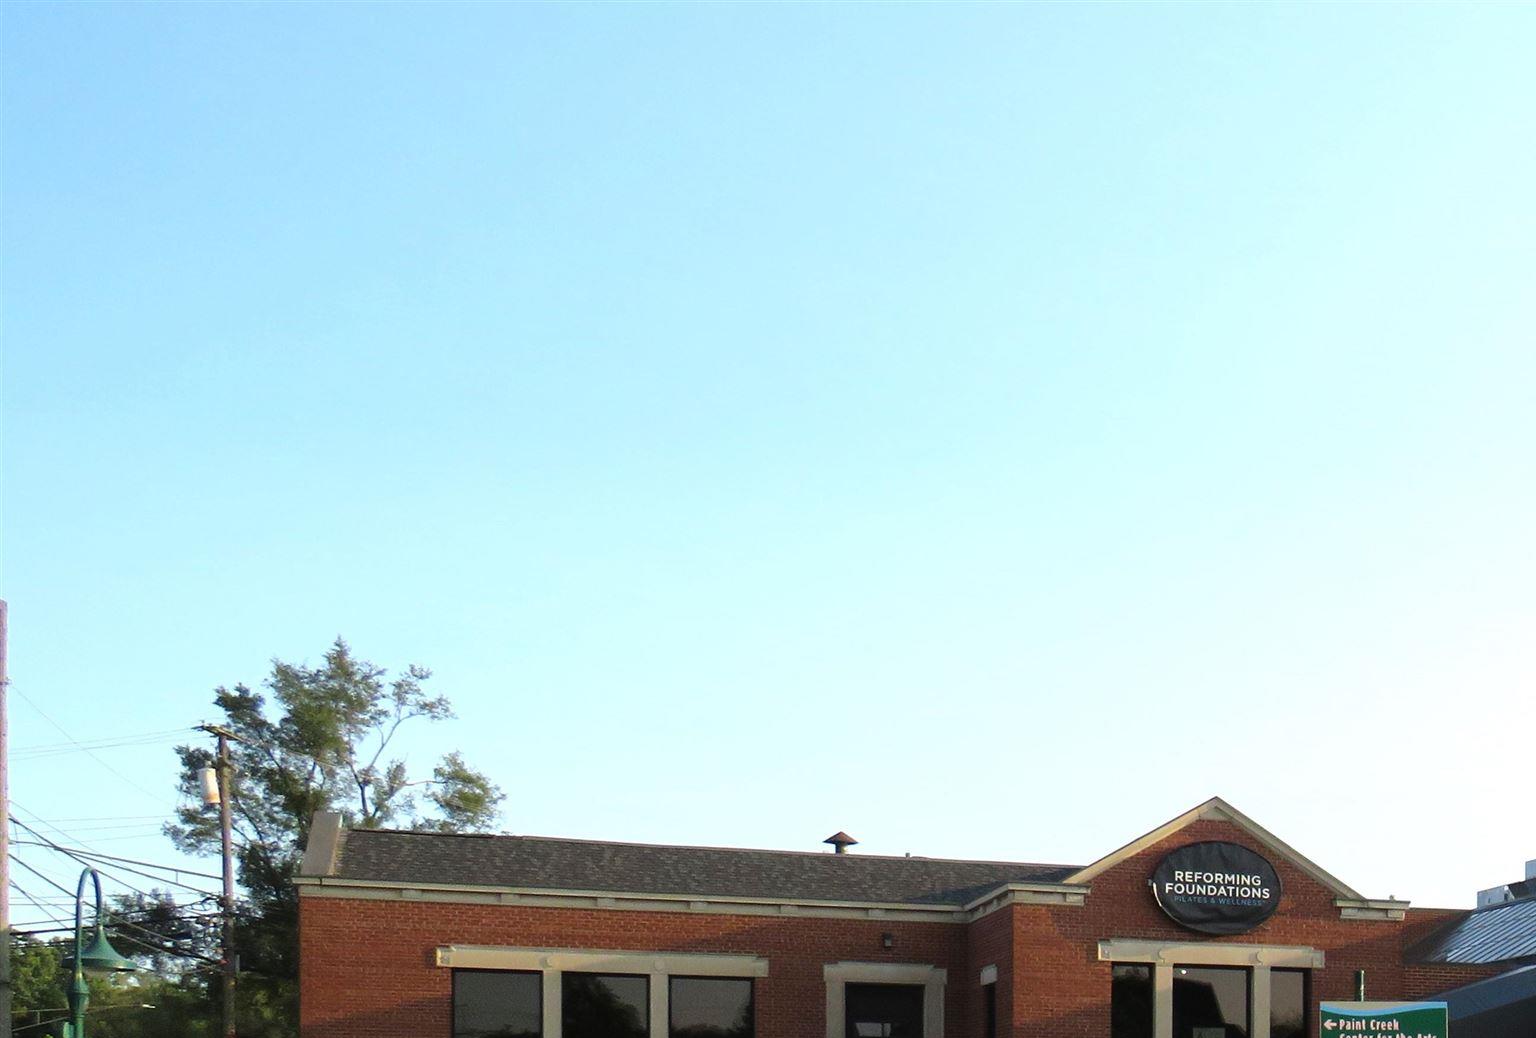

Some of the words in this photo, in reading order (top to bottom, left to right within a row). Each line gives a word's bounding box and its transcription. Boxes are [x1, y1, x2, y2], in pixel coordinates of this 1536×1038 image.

[1174, 870, 1262, 887] REFORMING
[1165, 882, 1270, 899] FOUNDATIONS
[1174, 896, 1208, 904] PILATES
[1218, 898, 1262, 906] WELLNESS
[1339, 1018, 1366, 1031] Paint
[1370, 1018, 1400, 1031] Creek
